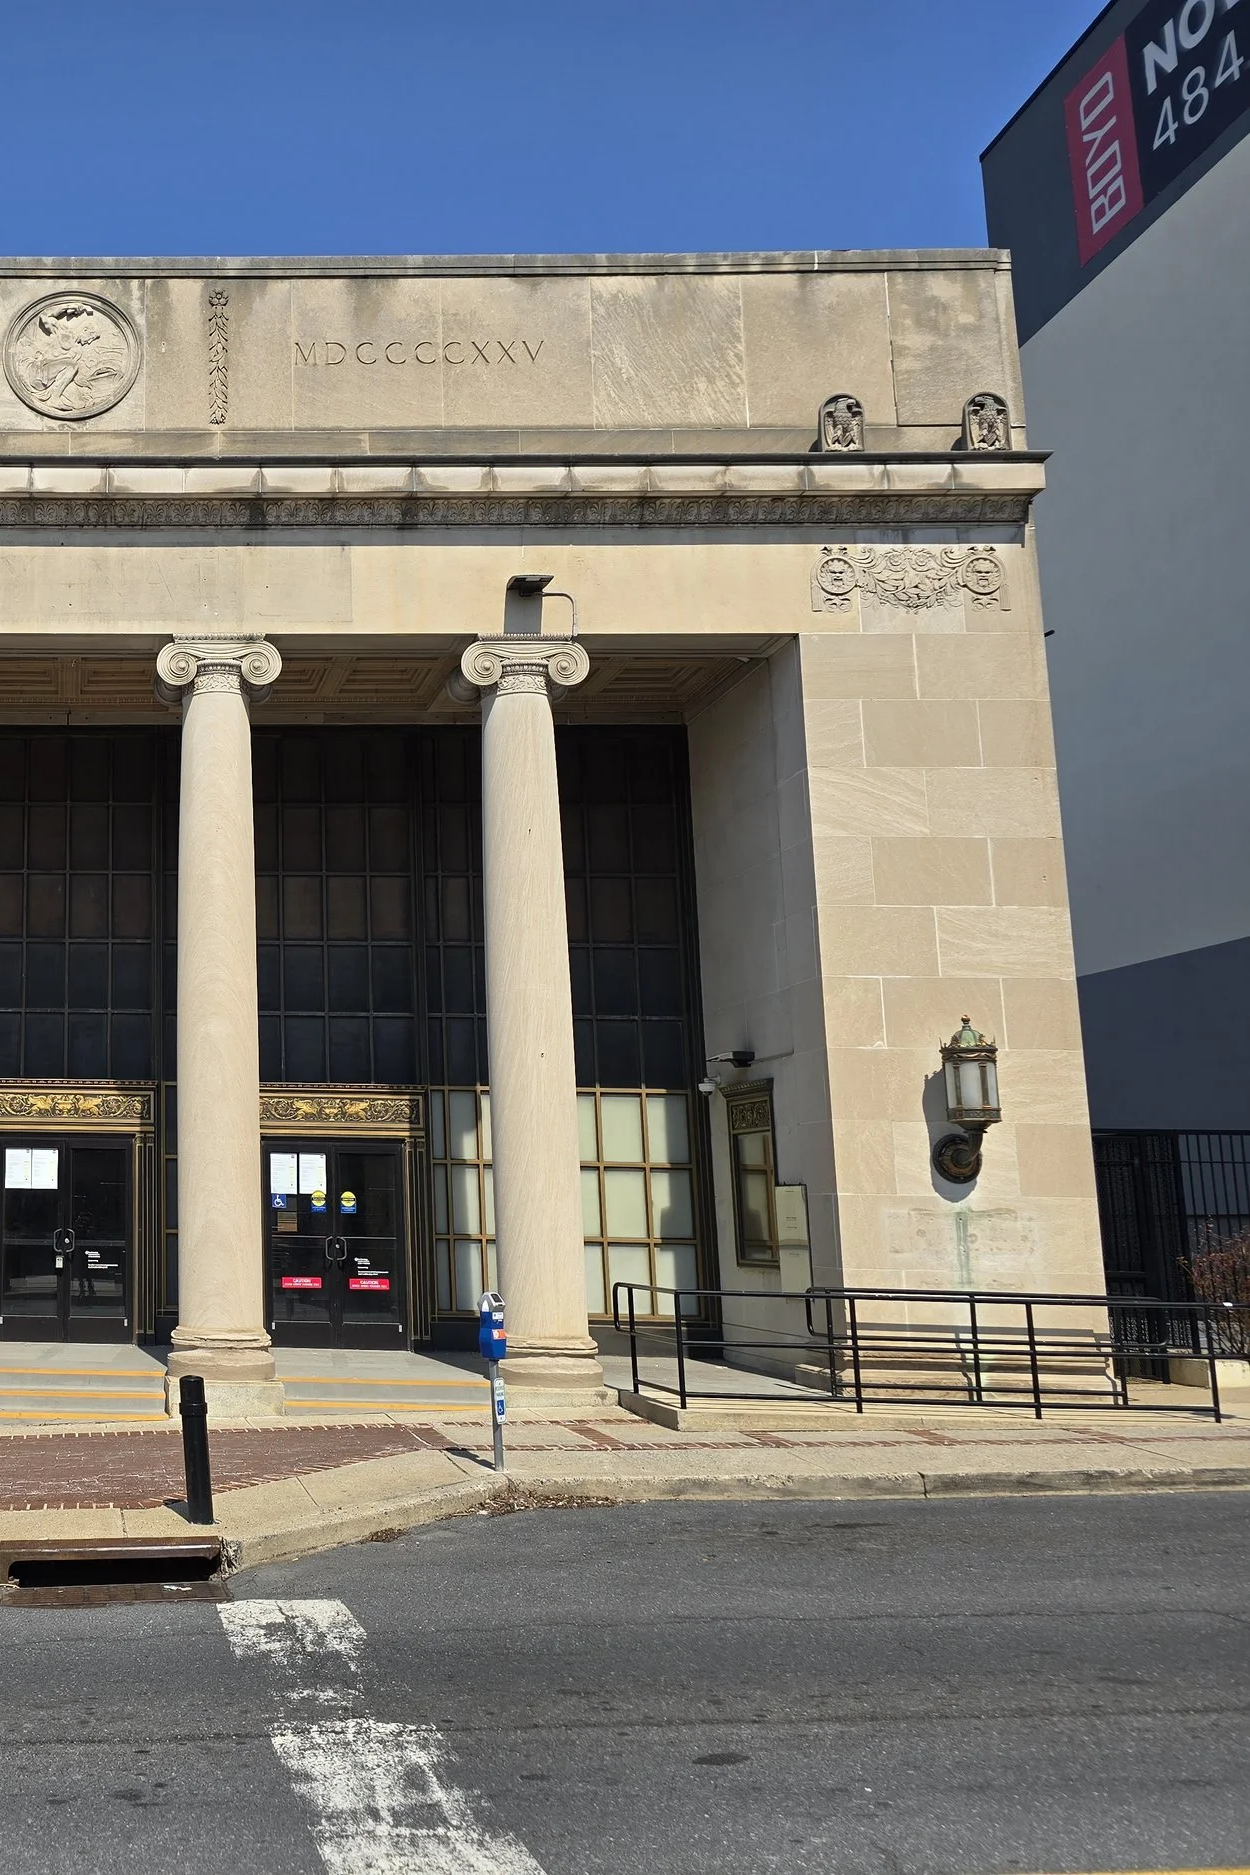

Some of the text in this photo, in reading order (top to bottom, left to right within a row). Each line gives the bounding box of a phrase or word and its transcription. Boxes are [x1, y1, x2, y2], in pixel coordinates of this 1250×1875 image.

[1142, 0, 1240, 96] NO
[1152, 29, 1245, 151] 484
[1079, 71, 1126, 235] BOYD
[294, 341, 545, 365] MDCCCCXXV
